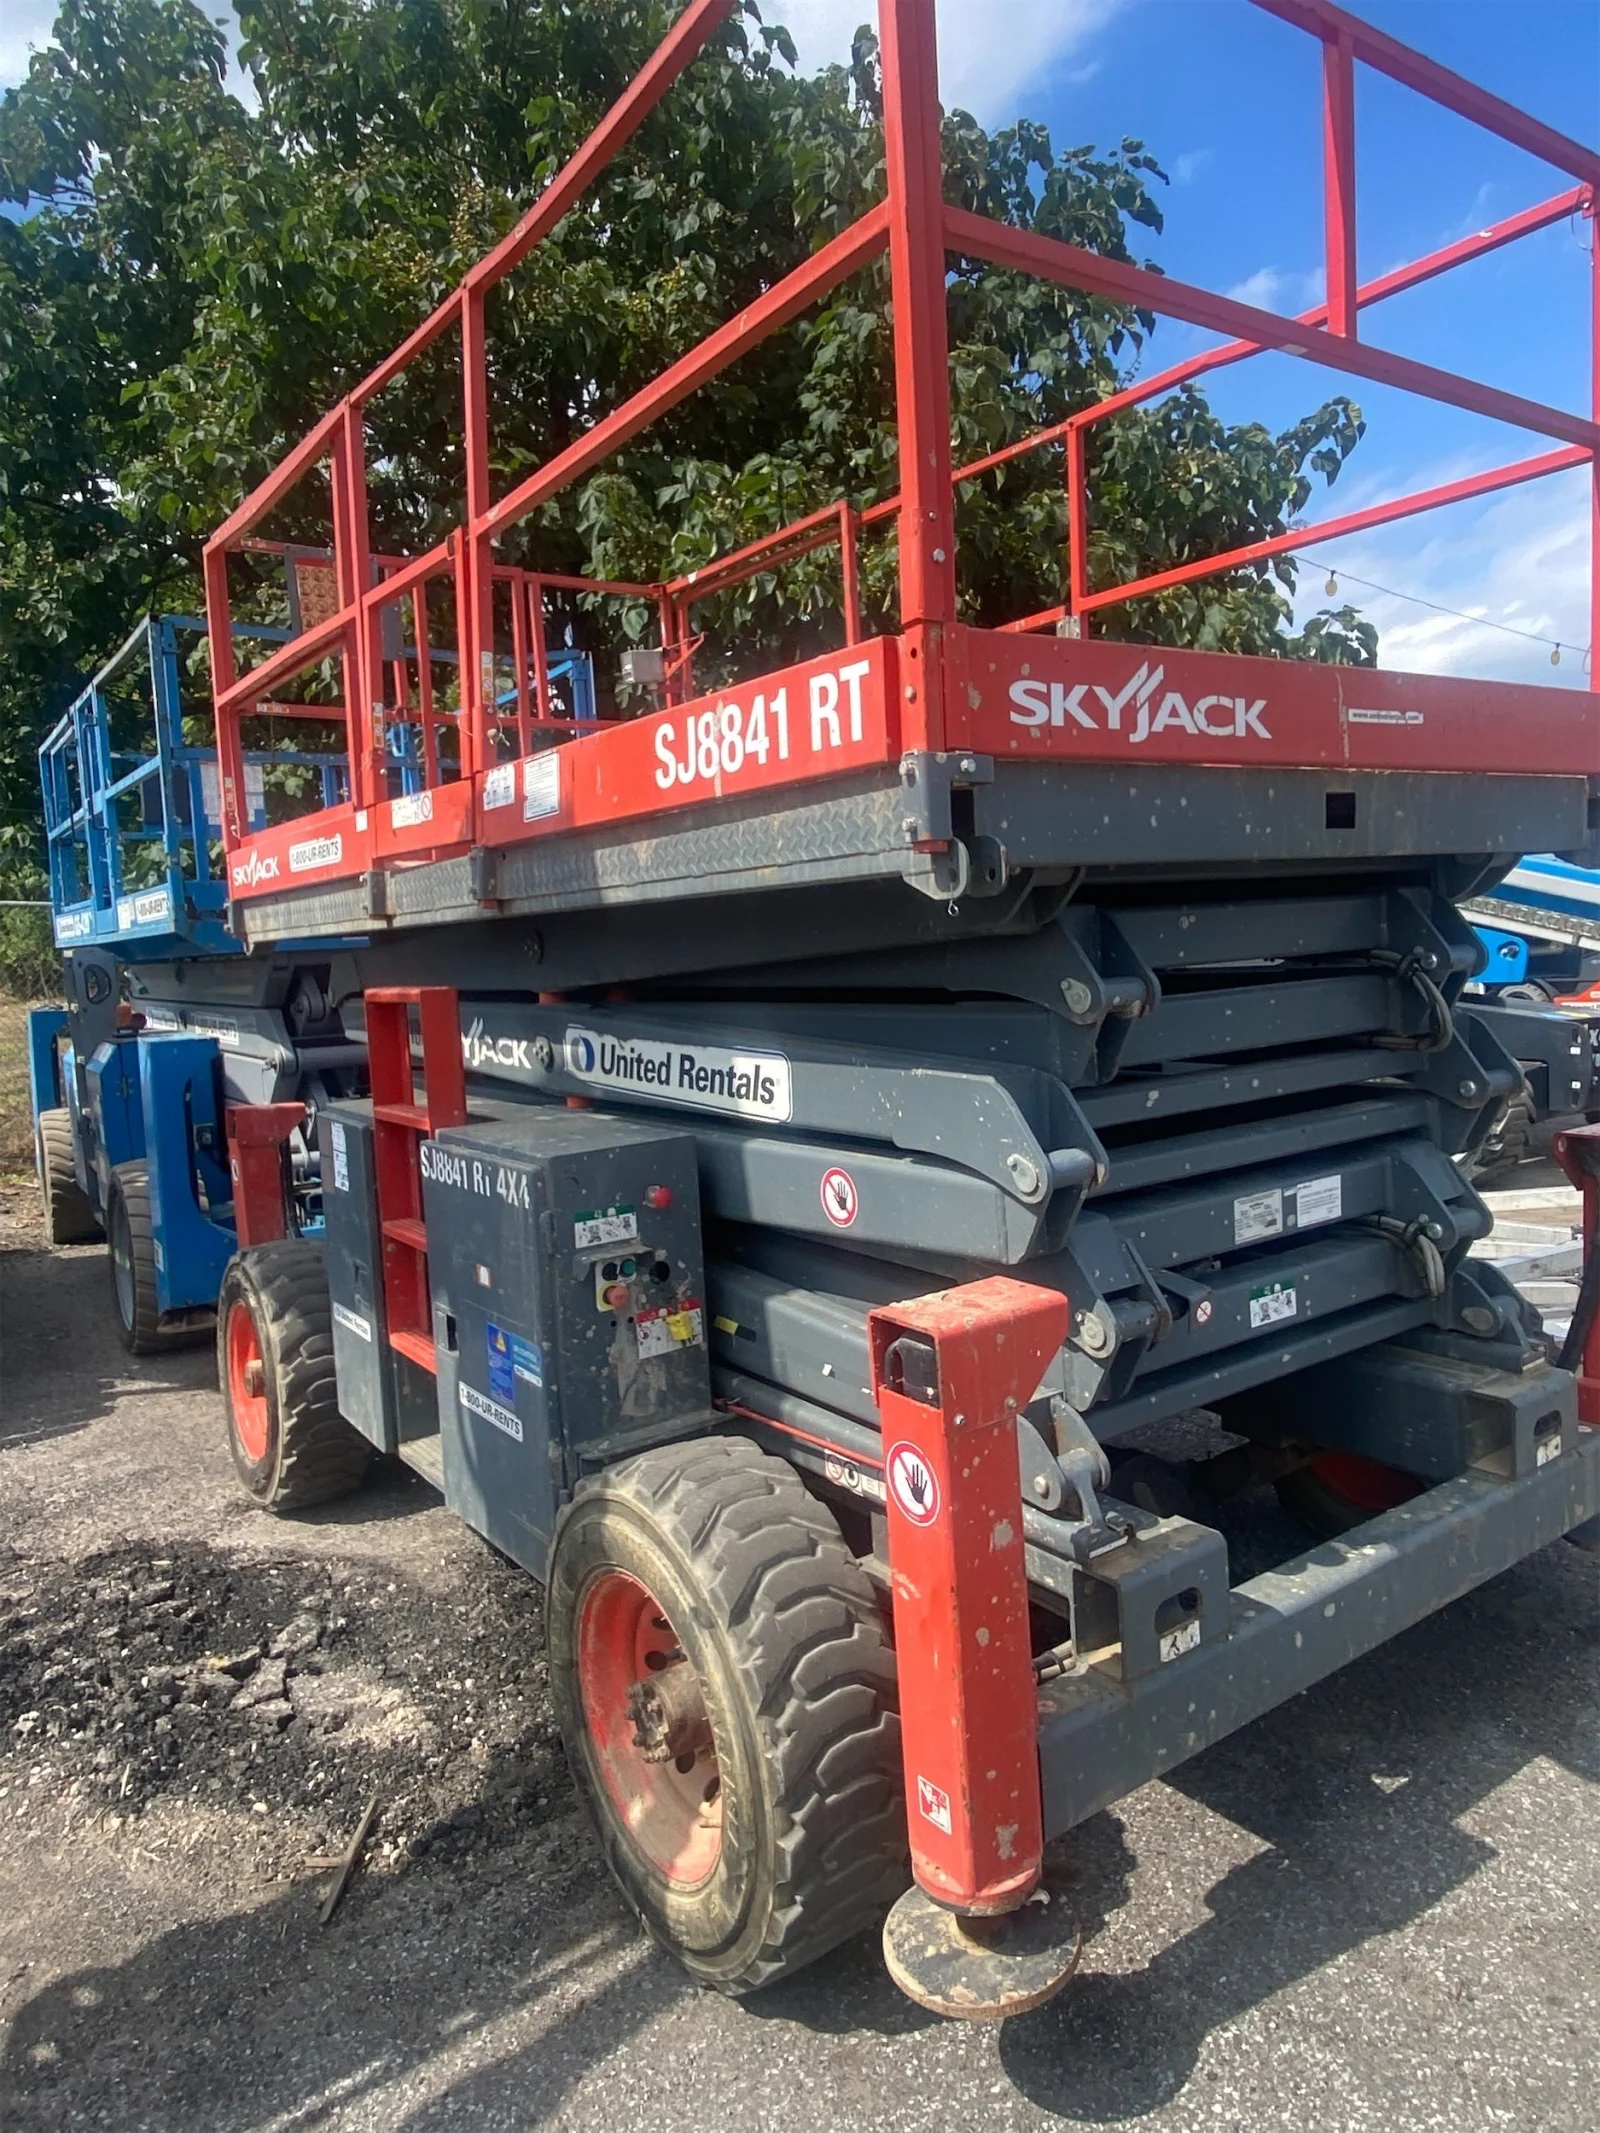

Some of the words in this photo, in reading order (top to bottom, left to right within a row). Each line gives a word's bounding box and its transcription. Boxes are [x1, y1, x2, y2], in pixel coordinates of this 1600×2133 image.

[654, 687, 790, 789] SJ8841
[809, 659, 870, 752] RT
[1008, 661, 1273, 743] SKYJACK
[232, 849, 280, 888] SKYJACK
[599, 1041, 671, 1086] United
[677, 1053, 776, 1105] Rentals
[421, 1145, 468, 1190] SJ8841
[460, 1387, 520, 1436] 1-800-UR-RENTS
